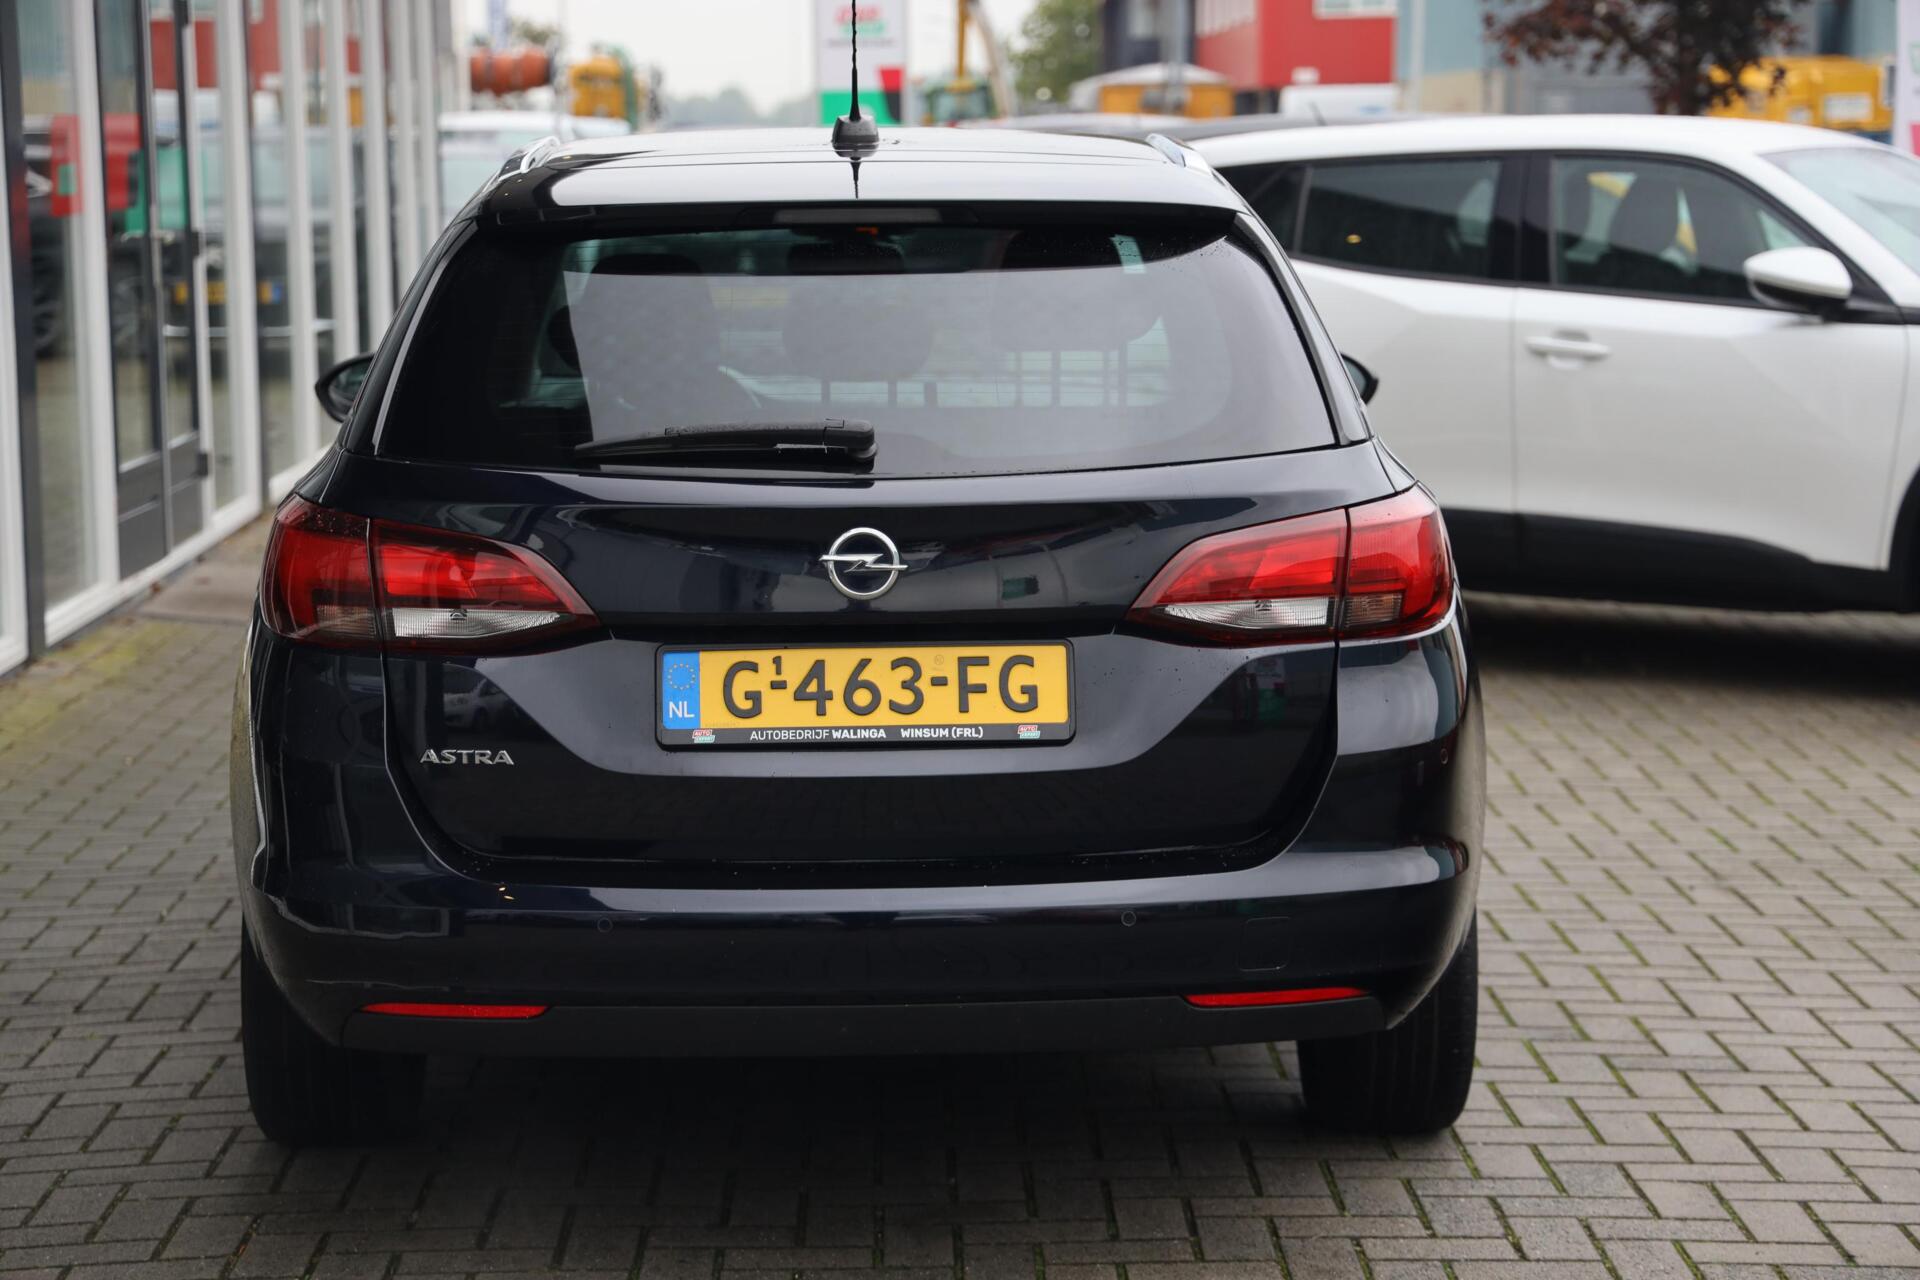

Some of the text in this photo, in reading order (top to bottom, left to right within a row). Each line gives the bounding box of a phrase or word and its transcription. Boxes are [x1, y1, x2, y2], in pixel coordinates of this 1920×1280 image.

[668, 701, 695, 719] NL
[750, 726, 984, 741] AUTOBEDRIJF WALINGA WINSUM (FRL)
[419, 748, 515, 766] ASTRA
